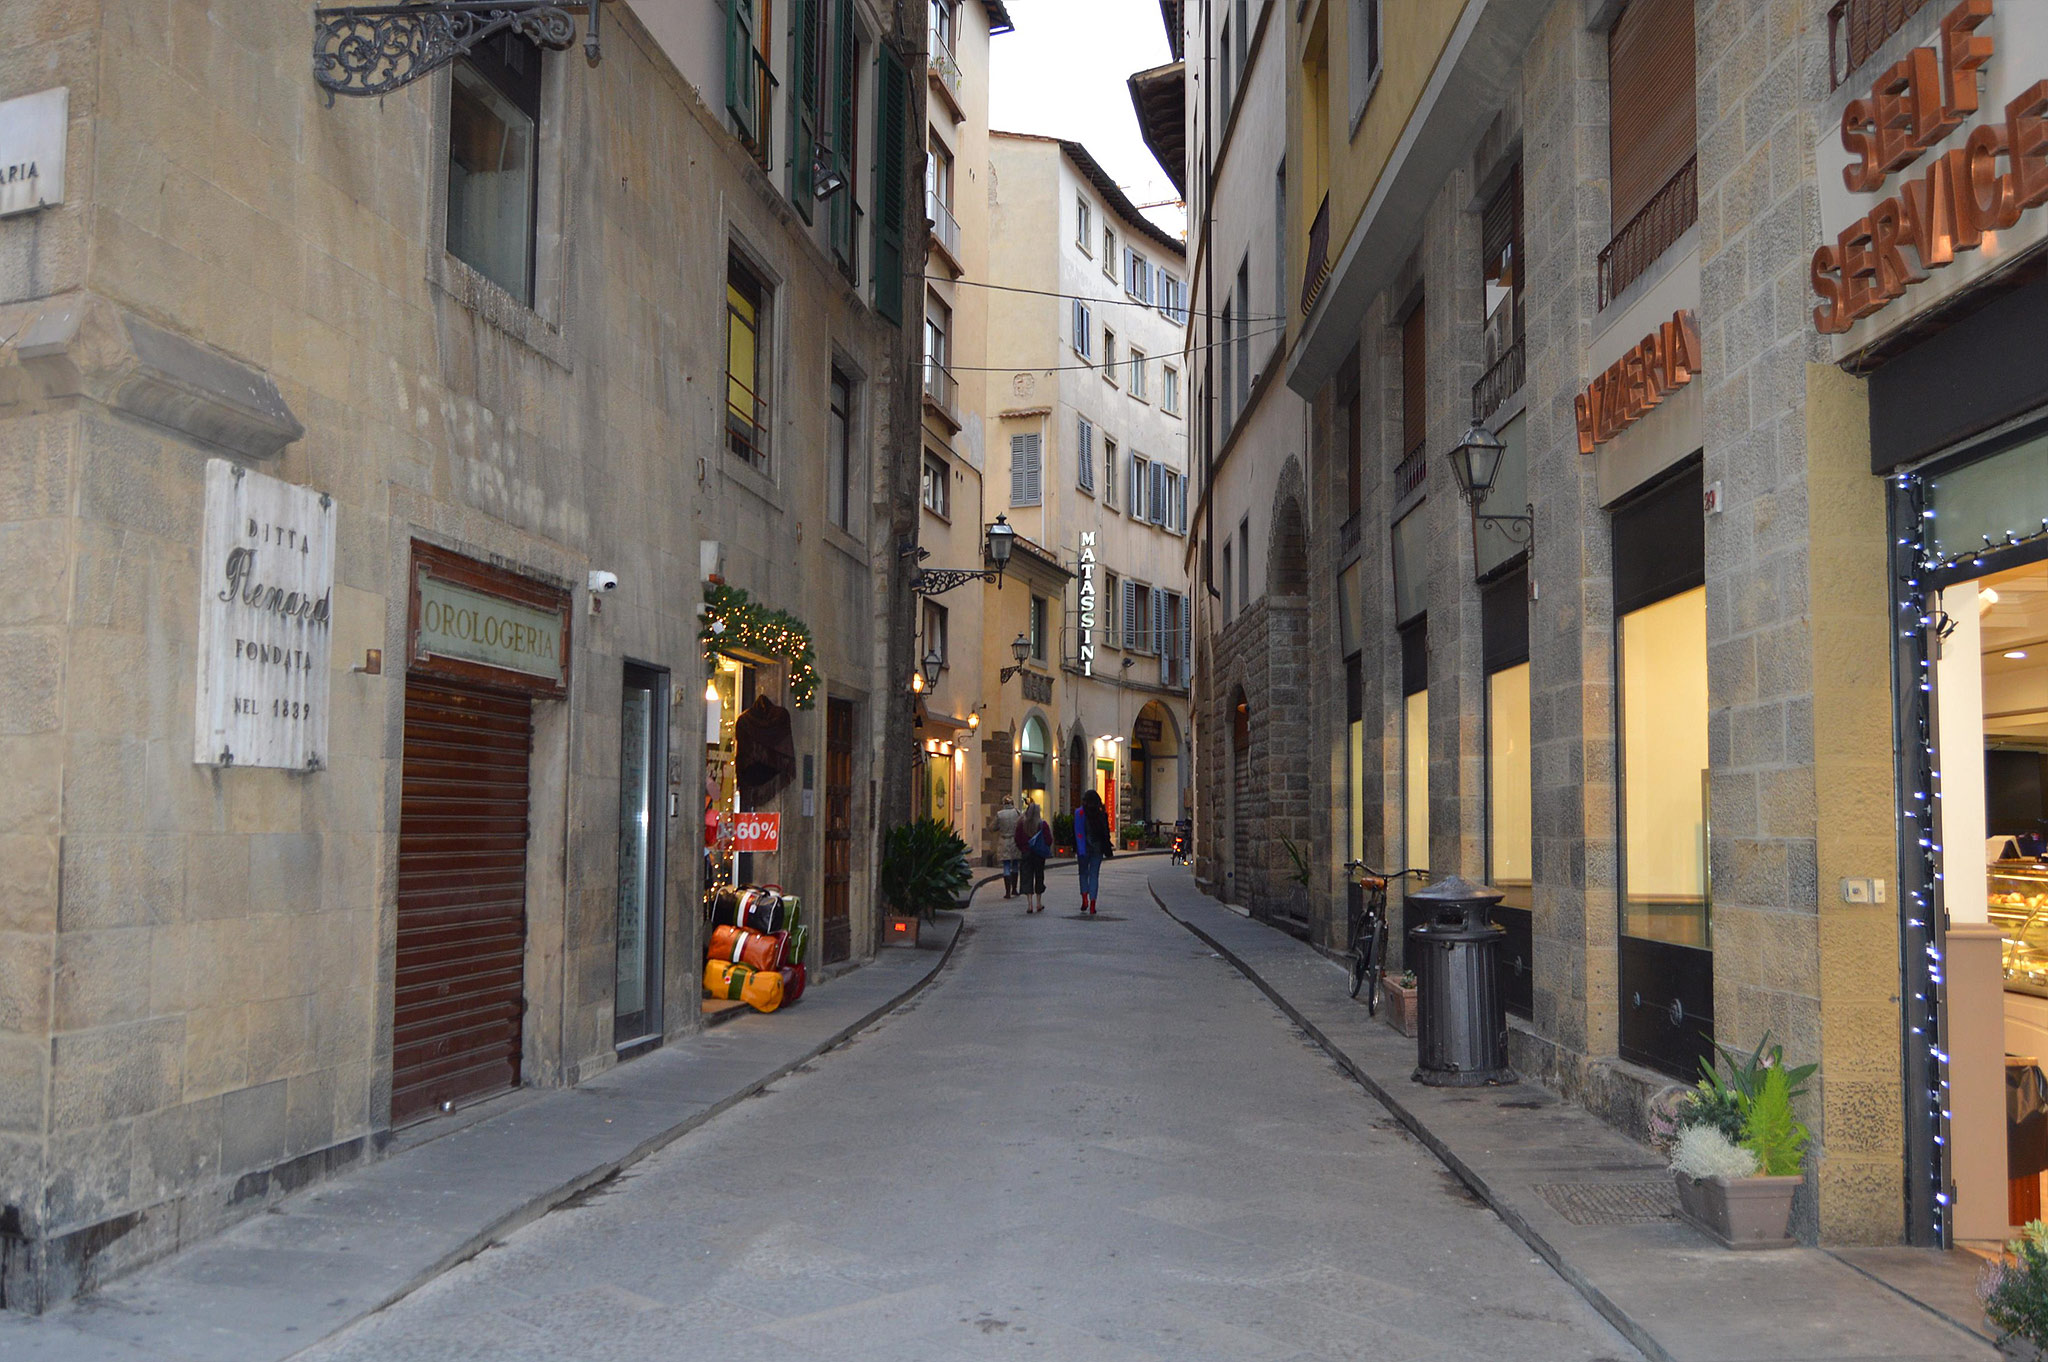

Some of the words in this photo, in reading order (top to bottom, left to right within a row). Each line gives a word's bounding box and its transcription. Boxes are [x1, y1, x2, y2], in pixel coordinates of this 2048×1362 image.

[1841, 0, 1994, 193] SELF
[1811, 79, 2048, 335] SERVICE
[1574, 309, 1702, 454] PIZZERIA
[248, 518, 309, 554] DITTA
[235, 638, 311, 670] FONDATA
[424, 600, 554, 659] OROLOGERIA
[1080, 531, 1097, 677] MATASSINI
[234, 697, 259, 716] NEL
